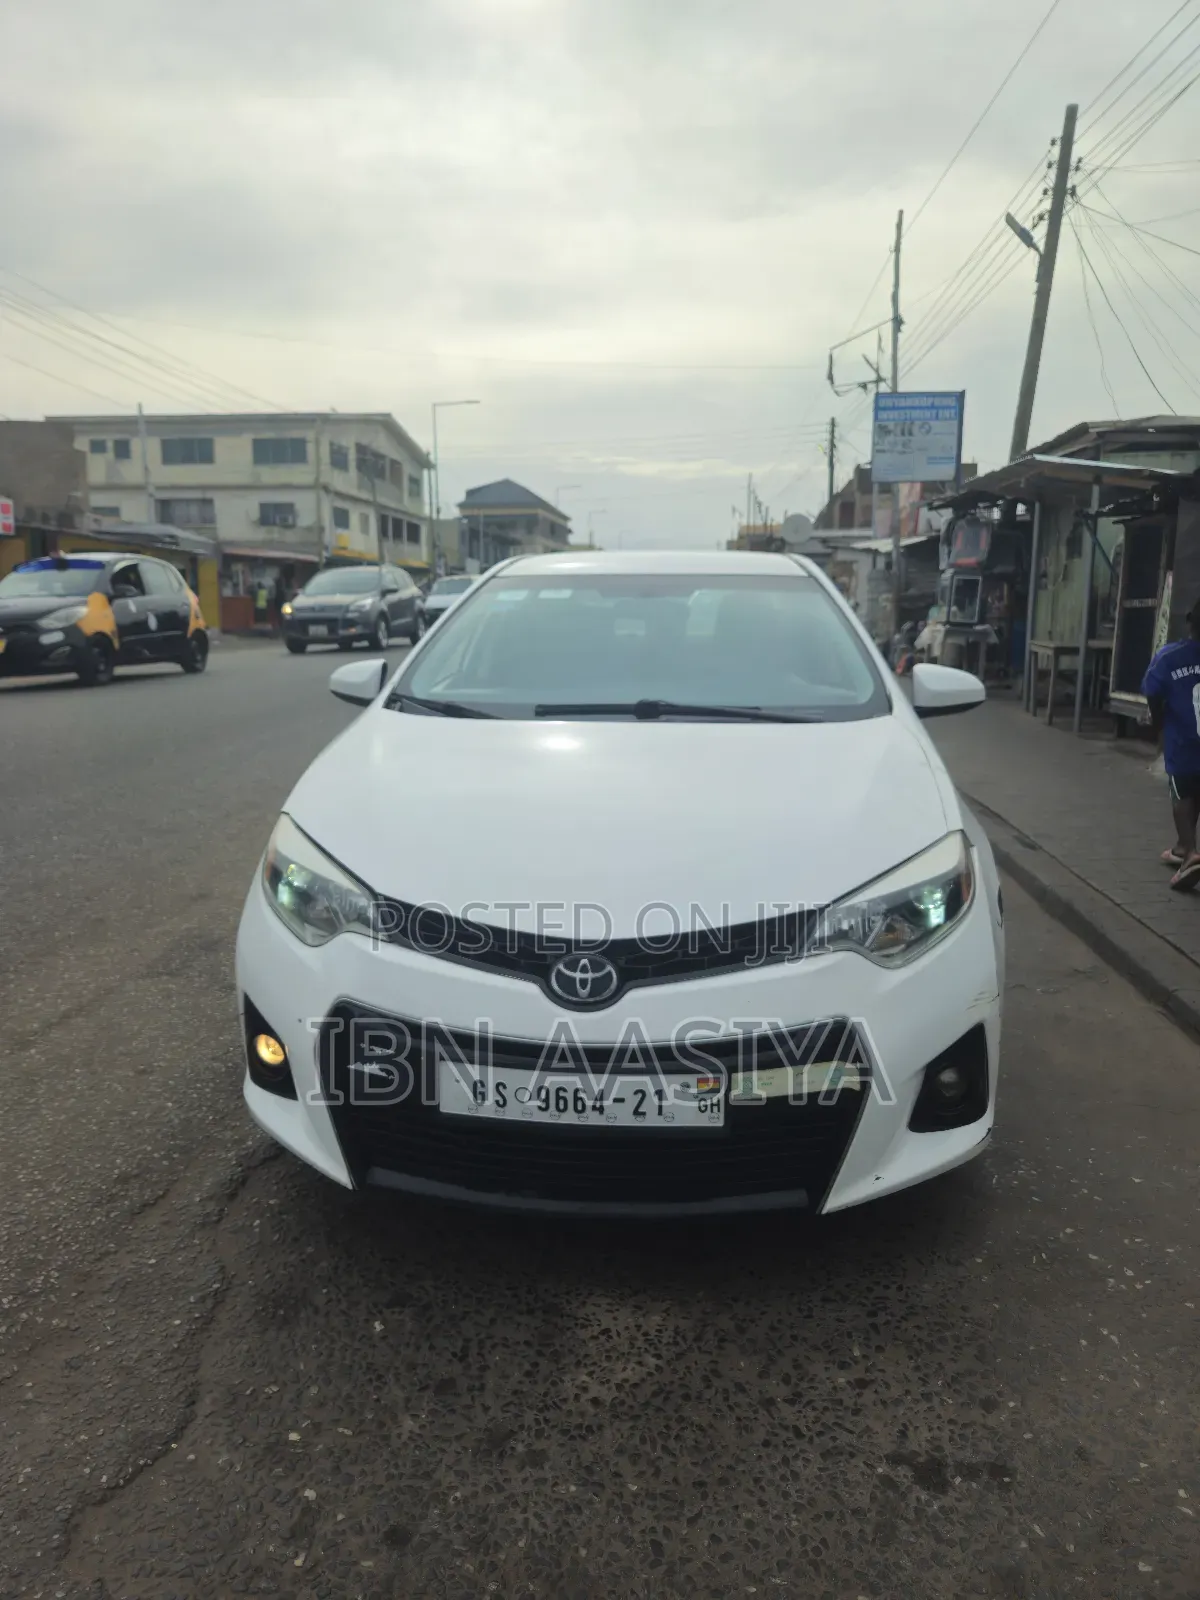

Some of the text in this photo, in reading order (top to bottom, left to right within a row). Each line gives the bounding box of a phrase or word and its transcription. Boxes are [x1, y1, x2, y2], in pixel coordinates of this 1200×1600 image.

[472, 1079, 663, 1117] GS 9664-21
[697, 1098, 721, 1113] GH
